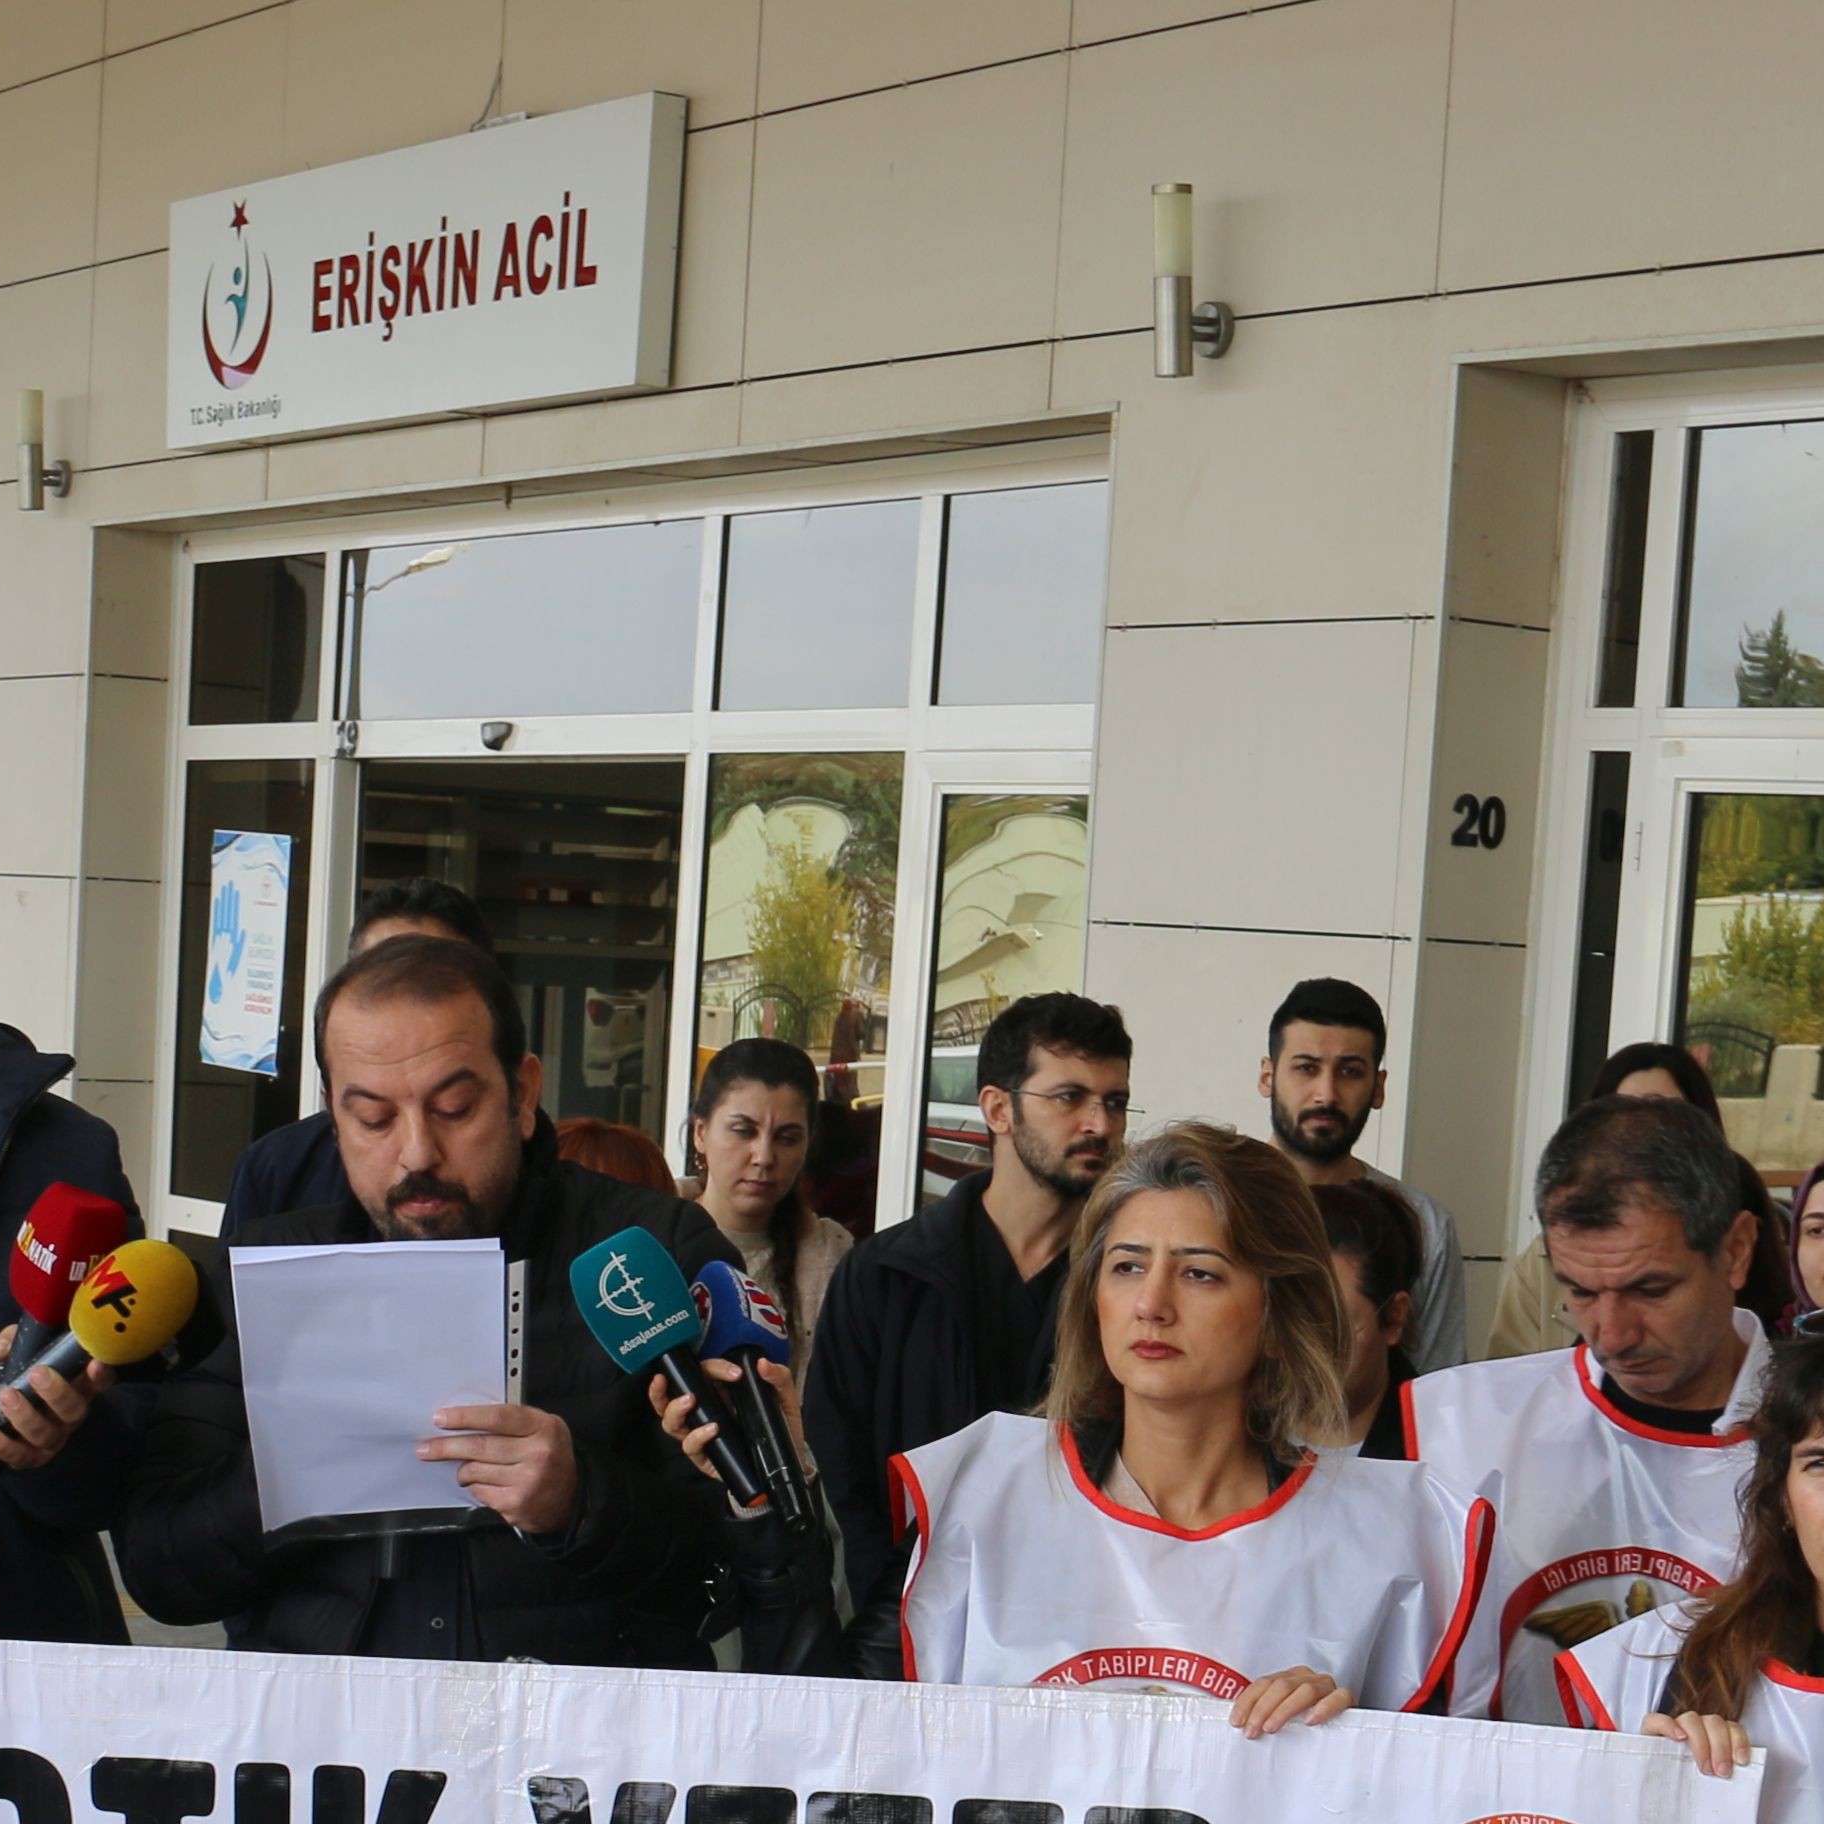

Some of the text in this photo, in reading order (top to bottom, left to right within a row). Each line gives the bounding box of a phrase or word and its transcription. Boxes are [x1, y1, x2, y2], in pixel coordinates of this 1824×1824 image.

[311, 191, 597, 342] ERİŞKİN ACİL
[1451, 793, 1506, 850] 20
[1081, 1651, 1199, 1682] TABİPLERİ
